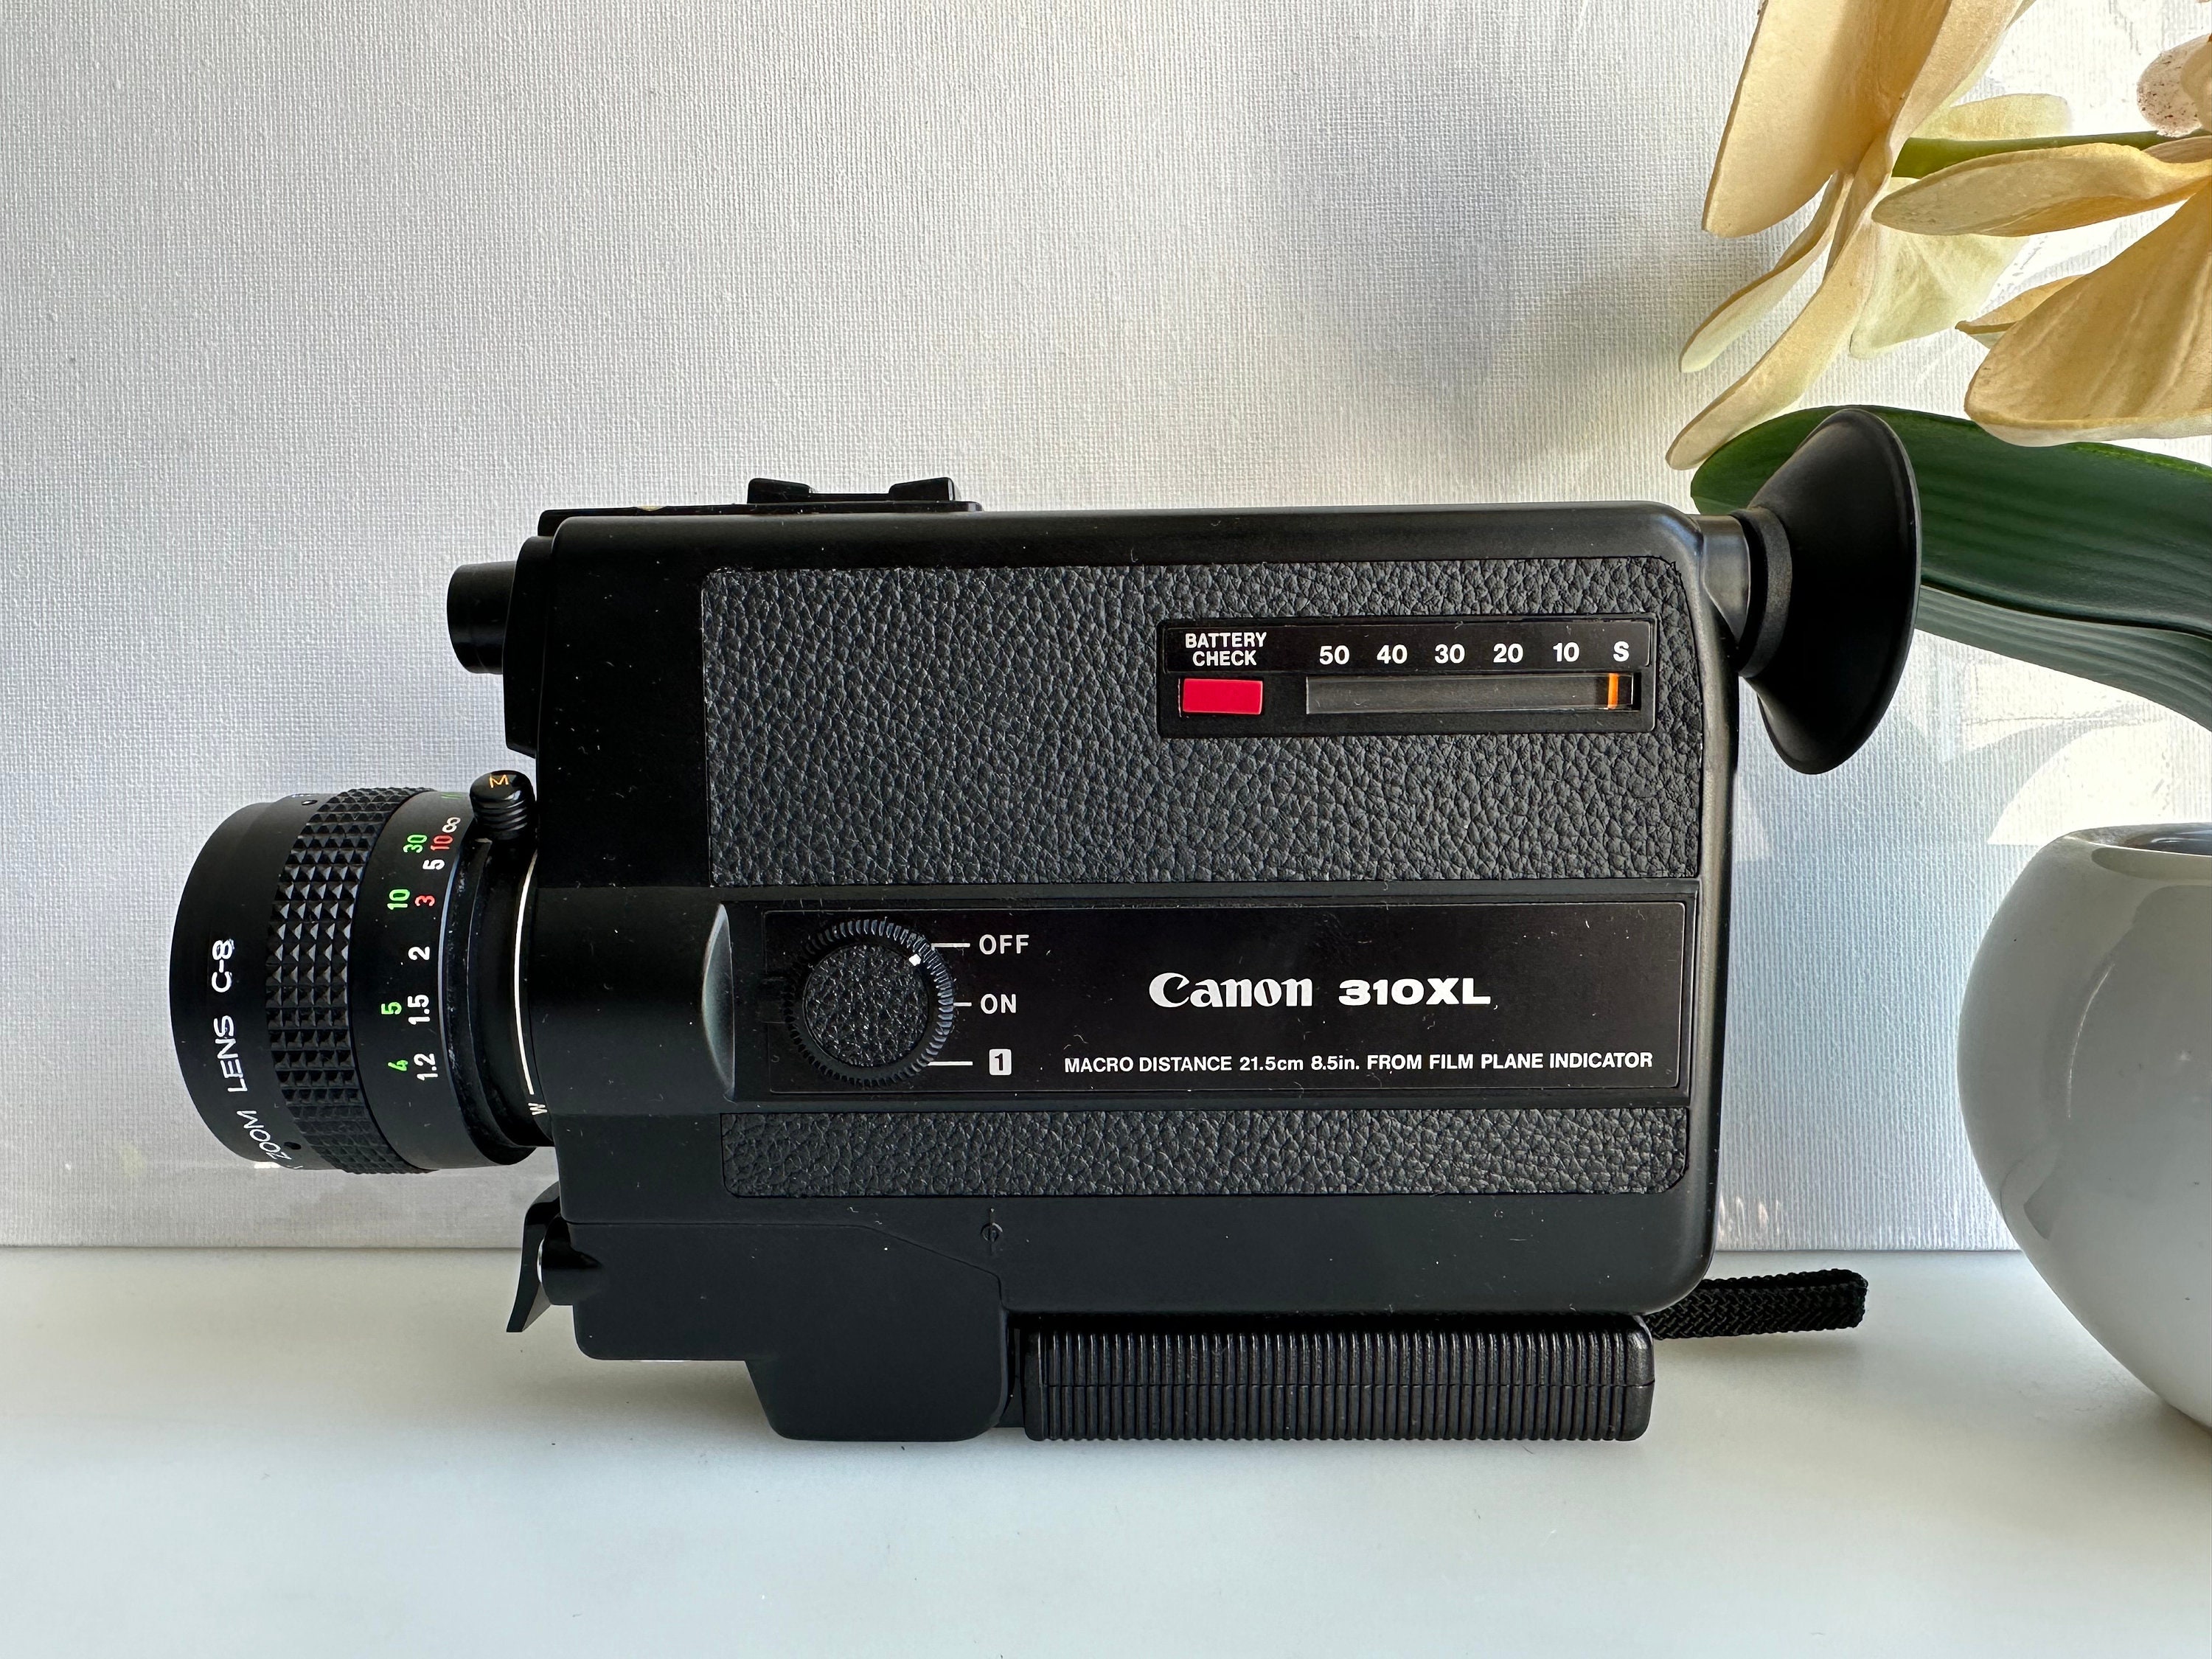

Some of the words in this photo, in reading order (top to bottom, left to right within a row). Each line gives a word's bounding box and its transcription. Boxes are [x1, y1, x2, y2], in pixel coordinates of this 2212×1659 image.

[1185, 631, 1267, 648] BATTERY
[1192, 650, 1257, 667] CHECK
[1319, 644, 1350, 665] 50
[1376, 644, 1408, 664] 40
[1434, 643, 1465, 664] 30
[1493, 643, 1524, 664] 20
[1552, 641, 1580, 662] 10
[1613, 641, 1630, 662] S
[489, 774, 509, 788] M
[403, 834, 428, 854] 30
[430, 835, 453, 852] 10
[422, 859, 445, 871] 5
[386, 888, 411, 911] 10
[414, 894, 436, 907] 3
[408, 946, 431, 961] 2
[978, 933, 1029, 955] OFF
[211, 938, 235, 993] C-8
[1149, 972, 1313, 1009] Canon
[1338, 977, 1492, 1006] 310XL
[380, 1001, 403, 1015] 5
[407, 994, 431, 1026] 1.5
[980, 993, 1018, 1015] ON
[213, 1015, 248, 1093] LENS
[1064, 1056, 1134, 1073] MACRO
[1139, 1055, 1232, 1072] DISTANCE
[1239, 1055, 1304, 1072] 21.5cm
[1310, 1054, 1360, 1071] 8.5in.
[1367, 1054, 1422, 1071] FROM
[1429, 1053, 1474, 1070] FILM
[1481, 1052, 1544, 1069] PLANE
[1549, 1051, 1653, 1069] INDICATOR
[387, 1060, 408, 1071] 4
[413, 1053, 439, 1081] 1.2
[236, 1110, 292, 1160] ZOOM
